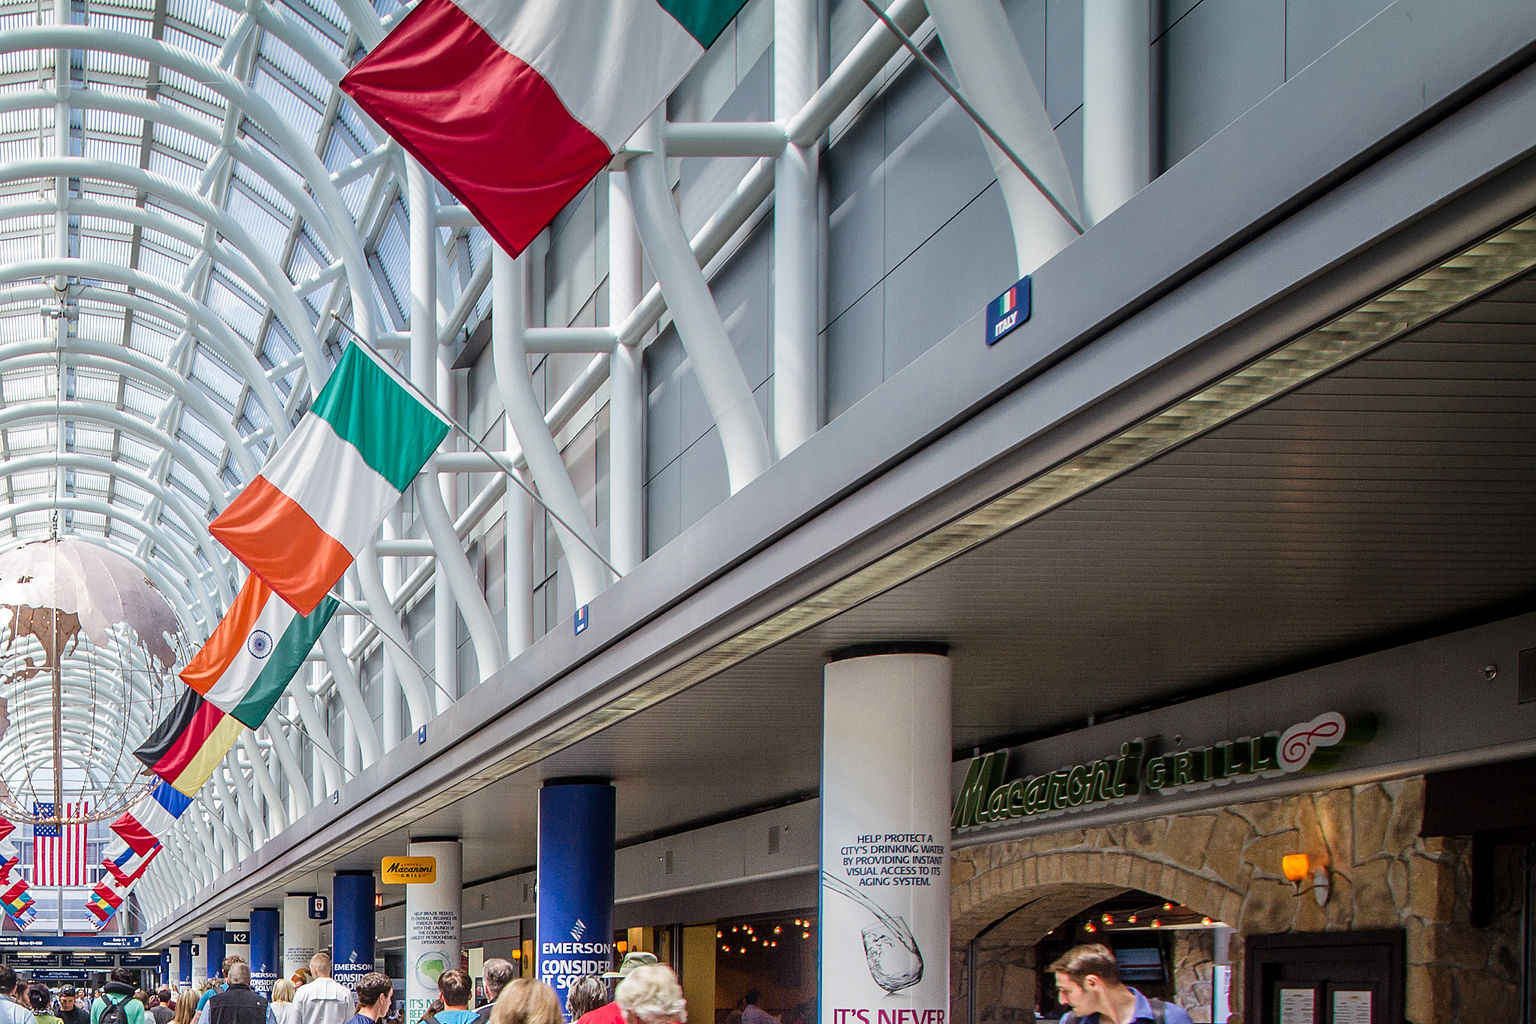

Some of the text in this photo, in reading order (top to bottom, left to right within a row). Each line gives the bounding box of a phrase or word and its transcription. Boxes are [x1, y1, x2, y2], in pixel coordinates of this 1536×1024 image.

[995, 310, 1018, 337] ITALY
[951, 737, 1272, 829] Macaroni GRILL
[857, 833, 933, 844] HELP PROTECT A
[840, 845, 944, 855] CITY'S DRINKING WATER
[843, 856, 943, 866] BY PROVIDING INSTANT
[387, 862, 433, 873] Macaroni
[846, 866, 941, 876] VISUAL ACCESS TO ITS
[859, 877, 931, 887] AGING SYSTEM.
[233, 933, 247, 942] K2
[542, 942, 611, 954] EMERSON
[334, 963, 373, 971] EMERSON
[542, 960, 611, 975] CONSIDER
[334, 973, 364, 982] CONSID
[409, 999, 424, 1009] IT'S
